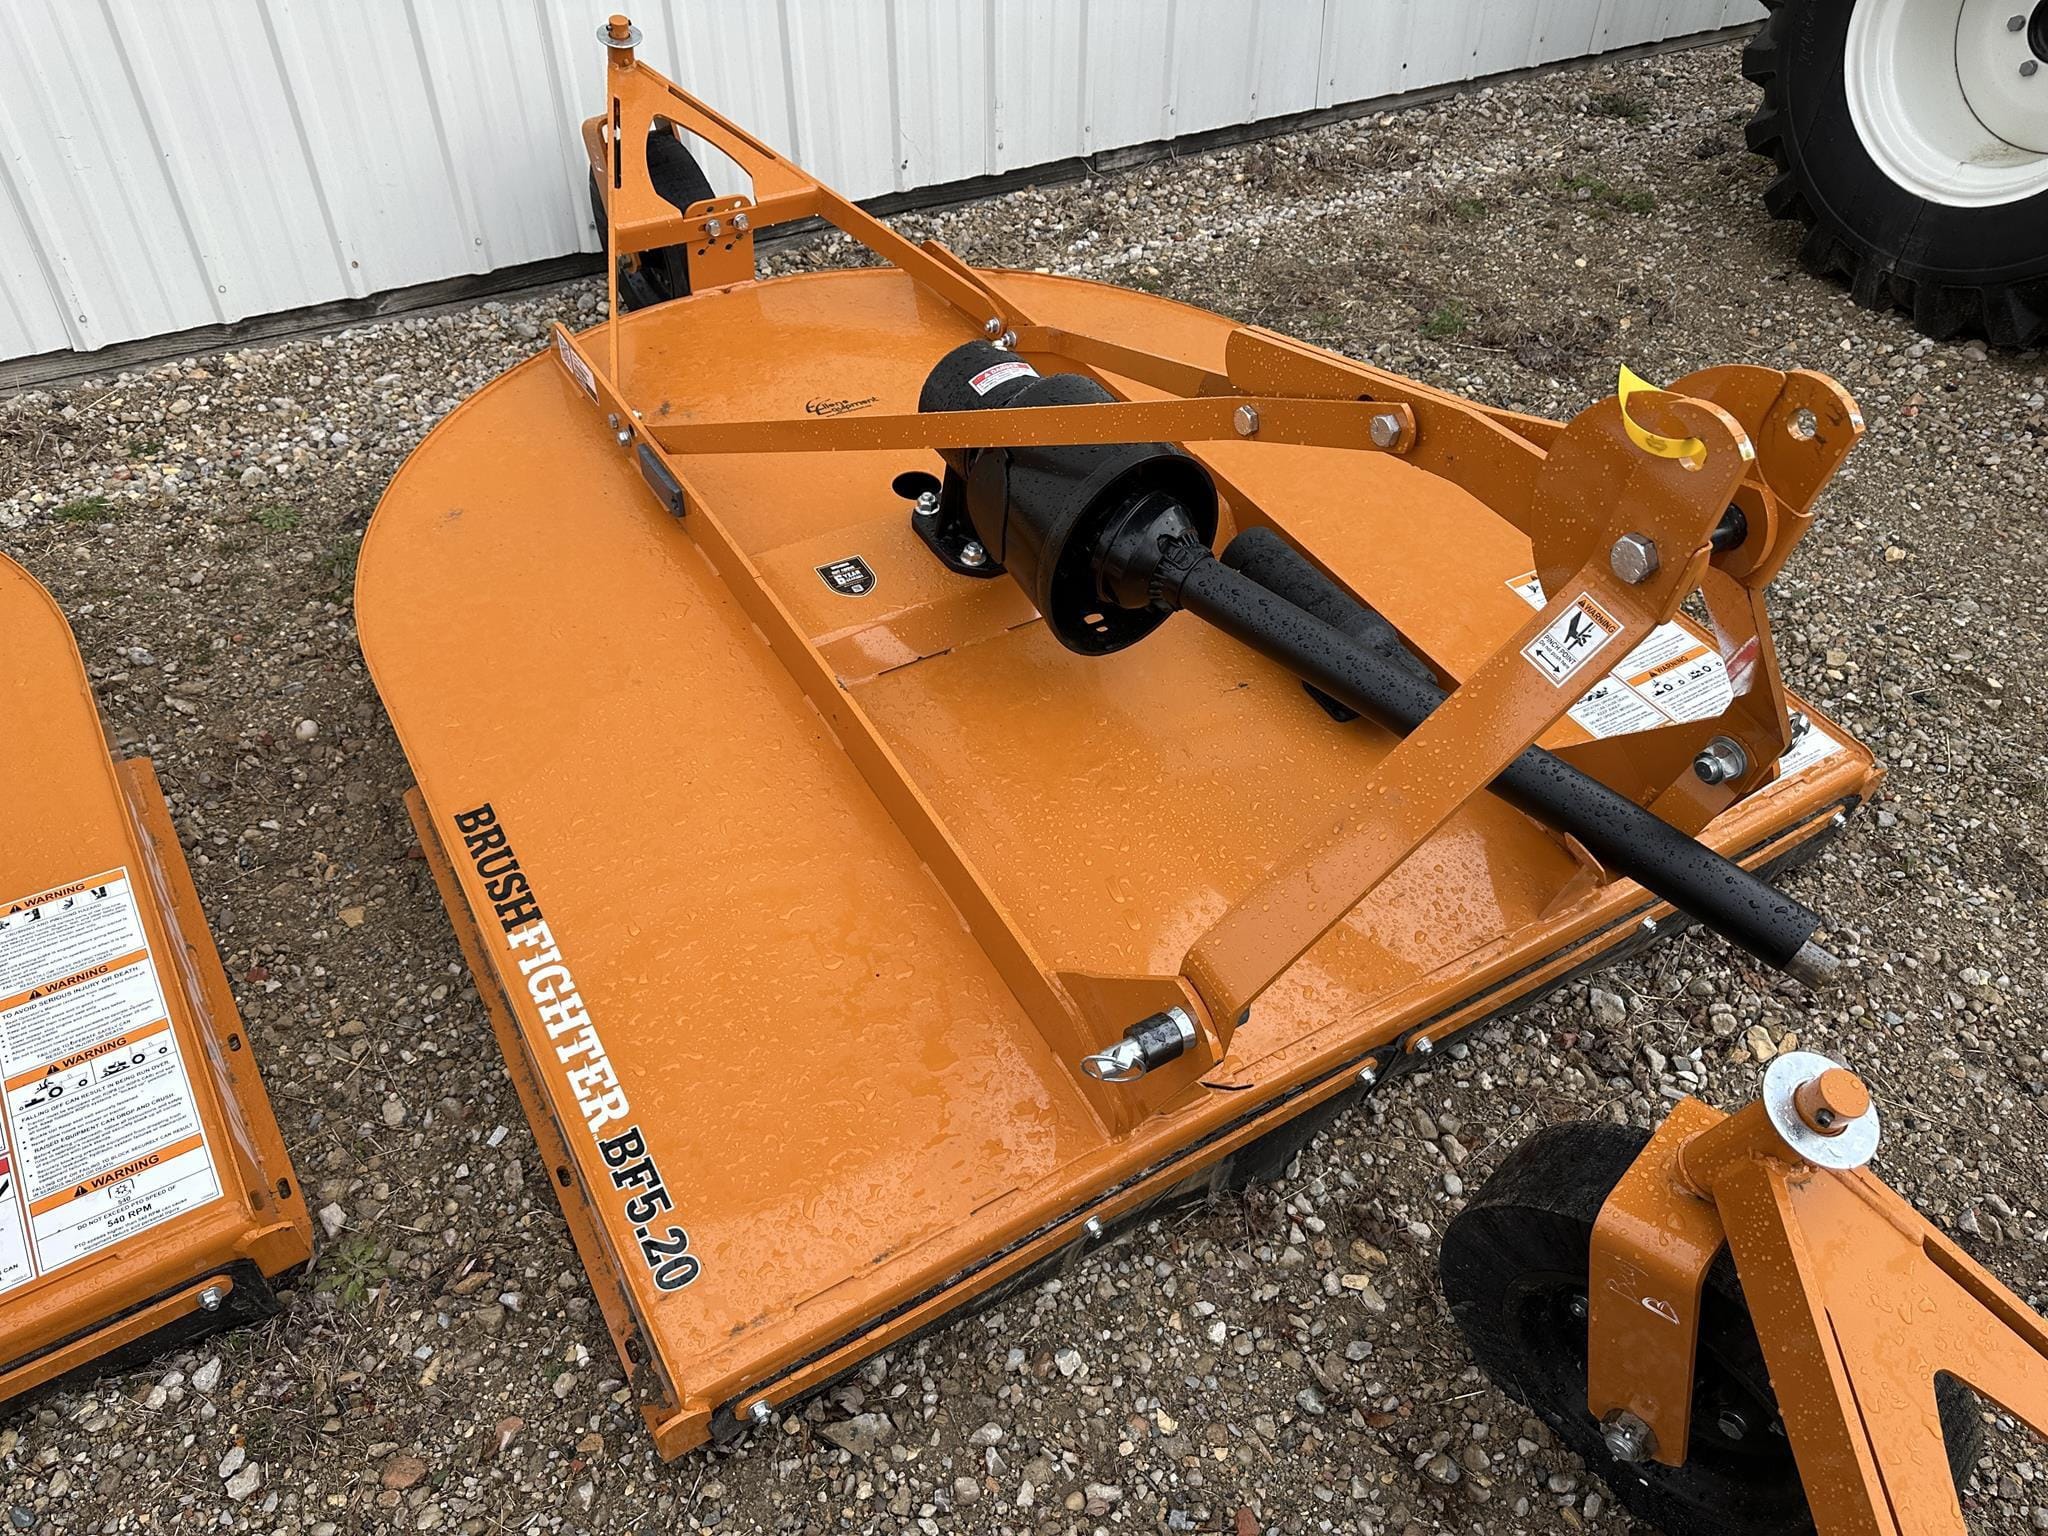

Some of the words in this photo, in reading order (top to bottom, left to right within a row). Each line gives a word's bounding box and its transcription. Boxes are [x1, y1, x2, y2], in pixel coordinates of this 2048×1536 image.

[1584, 604, 1616, 633] WARNING
[1543, 634, 1561, 650] PINCH
[1560, 648, 1576, 665] POINT
[1653, 655, 1689, 674] WARNING
[24, 883, 85, 907] WARNING
[14, 1004, 36, 1014] AVOID
[39, 991, 71, 1005] SERIOUS
[73, 981, 99, 992] INJURY
[113, 967, 137, 977] DEATH
[45, 965, 108, 992] WARNING
[62, 1037, 127, 1067] WARNING
[21, 1109, 48, 1122] FALLING
[65, 1096, 79, 1104] CAN
[81, 1086, 105, 1098] RESULT
[115, 1074, 134, 1084] BEING
[136, 1068, 150, 1076] RUN
[34, 1140, 58, 1152] RAISED
[61, 1123, 99, 1141] EQUIPMENT
[100, 1117, 114, 1125] CAN
[116, 1109, 134, 1118] DROP
[91, 1154, 159, 1188] WARNING
[77, 1222, 87, 1230] DO
[88, 1216, 102, 1225] NOT
[104, 1205, 129, 1219] EXCEED
[131, 1198, 143, 1207] PTO
[145, 1189, 166, 1201] SPEED
[107, 1214, 125, 1227] 540
[127, 1203, 151, 1218] RPM
[598, 1124, 702, 1292] BF5.20
[3, 1263, 18, 1274] CAN
